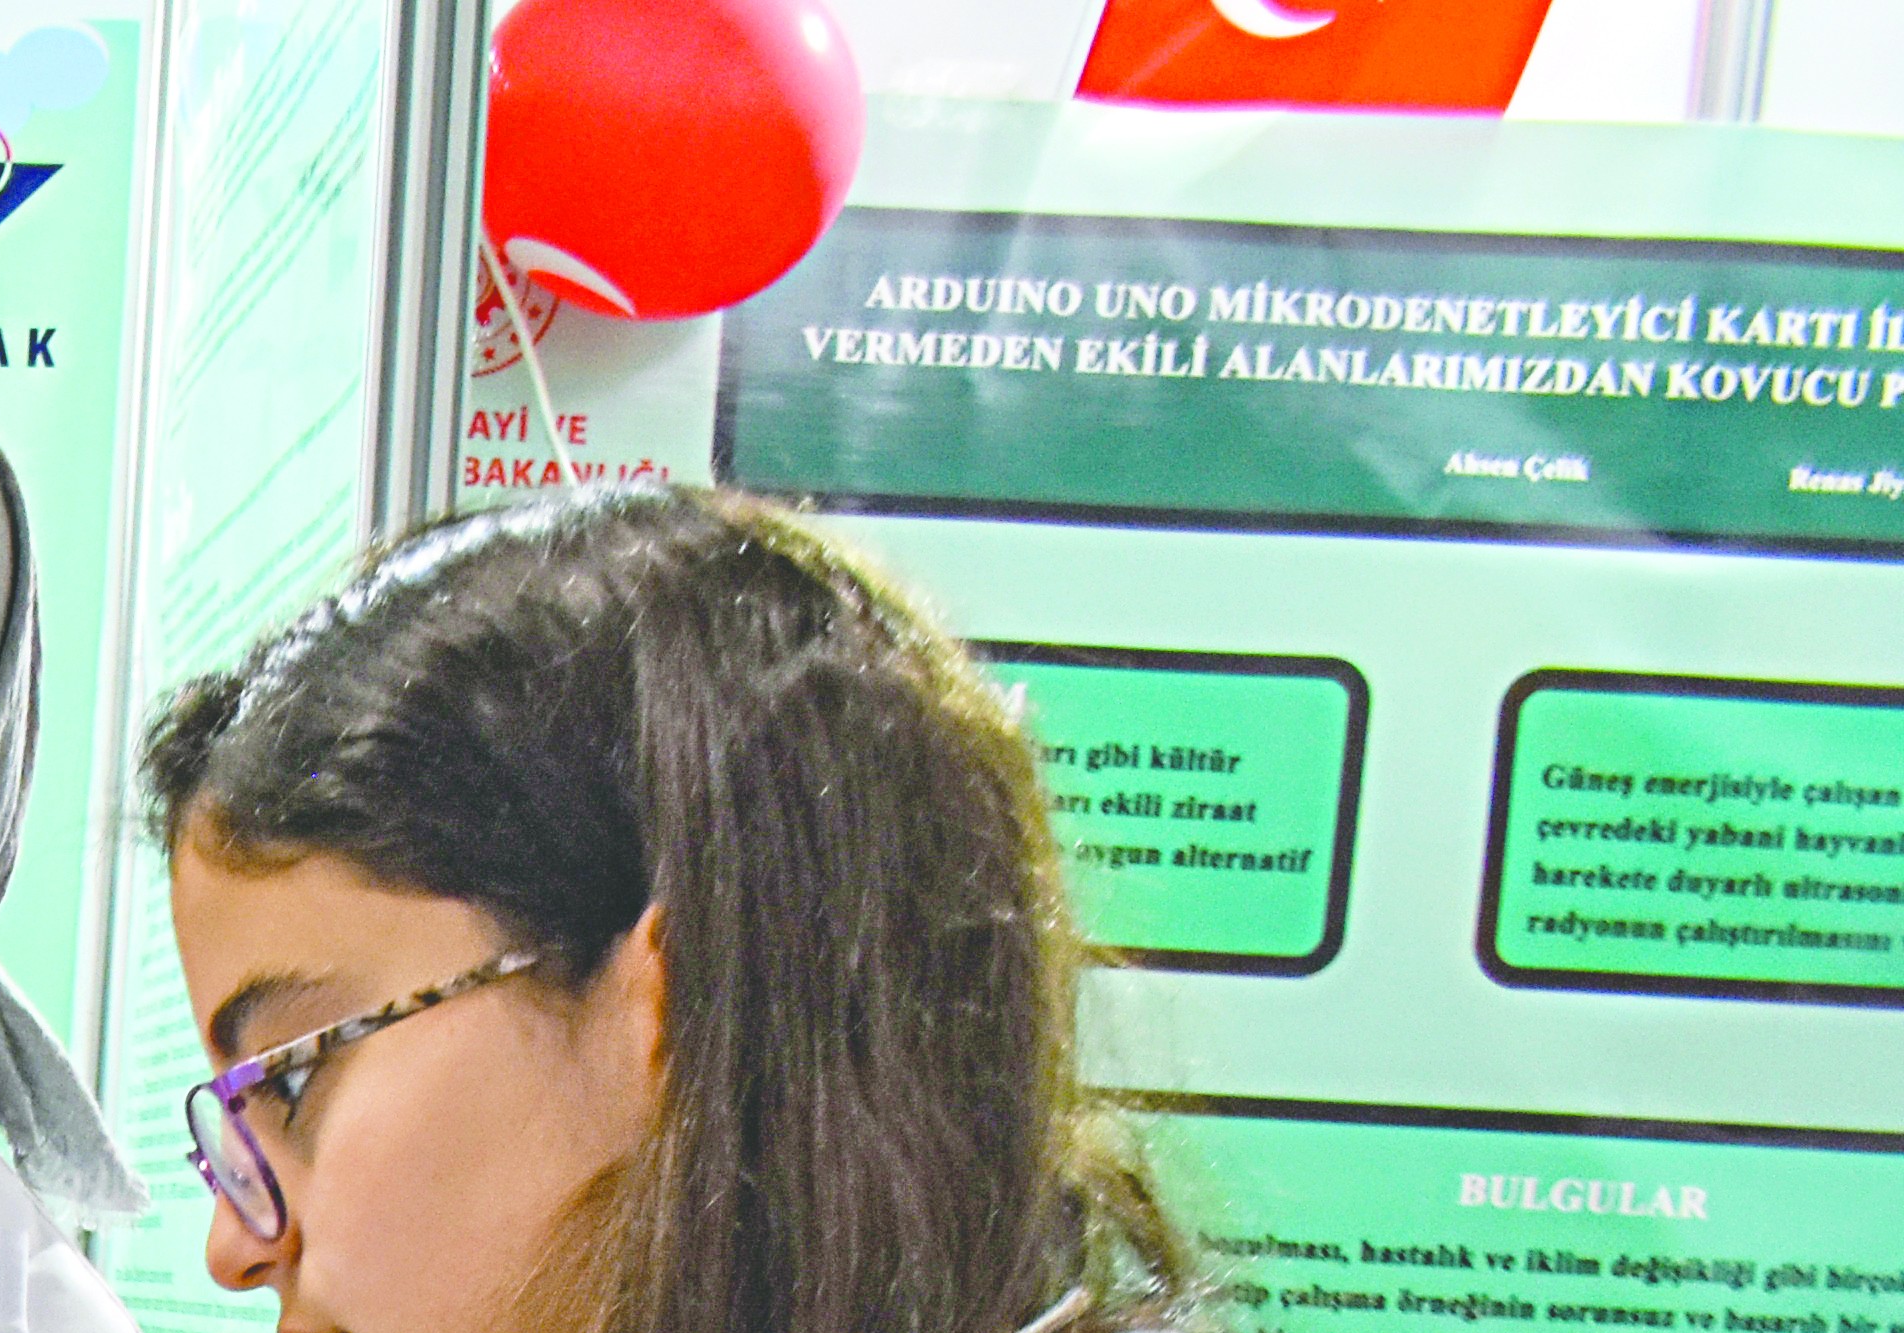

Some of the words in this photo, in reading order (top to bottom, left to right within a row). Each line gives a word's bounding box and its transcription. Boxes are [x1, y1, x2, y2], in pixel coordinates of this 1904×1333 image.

[865, 274, 1083, 318] ARDUINO
[1094, 282, 1196, 322] UNO
[1206, 281, 1698, 343] MİKRODENETLEYİCİ
[1707, 305, 1864, 350] KARTI
[801, 325, 1062, 372] VERMEDEN
[1074, 332, 1208, 379] EKİLİ
[1218, 342, 1655, 398] ALANLARIMIZDAN
[1666, 362, 1869, 408] KOVUCU
[1086, 743, 1141, 773] gibi
[1149, 744, 1242, 774] kültür
[1542, 763, 1635, 800] Güneş
[1642, 770, 1795, 806] enerjisiyle
[1100, 792, 1163, 819] ekili
[1171, 796, 1258, 823] ziraat
[1537, 816, 1678, 844] çevredeki
[1685, 821, 1785, 852] yabani
[1172, 844, 1312, 874] alternatif
[1532, 860, 1658, 891] harekete
[1667, 868, 1773, 901] duyarlı
[1526, 910, 1667, 944] radyonun
[1459, 1173, 1707, 1220] BULGULAR
[1360, 1239, 1475, 1270] hastalık
[1486, 1252, 1516, 1271] ve
[1526, 1248, 1600, 1276] iklim
[1611, 1254, 1755, 1289] değişikliği
[1764, 1263, 1817, 1293] gibi
[1280, 1283, 1387, 1313] çalışma
[1398, 1287, 1534, 1322] örneğinin
[1547, 1304, 1675, 1330] sorunsuz
[1685, 1311, 1715, 1331] ve
